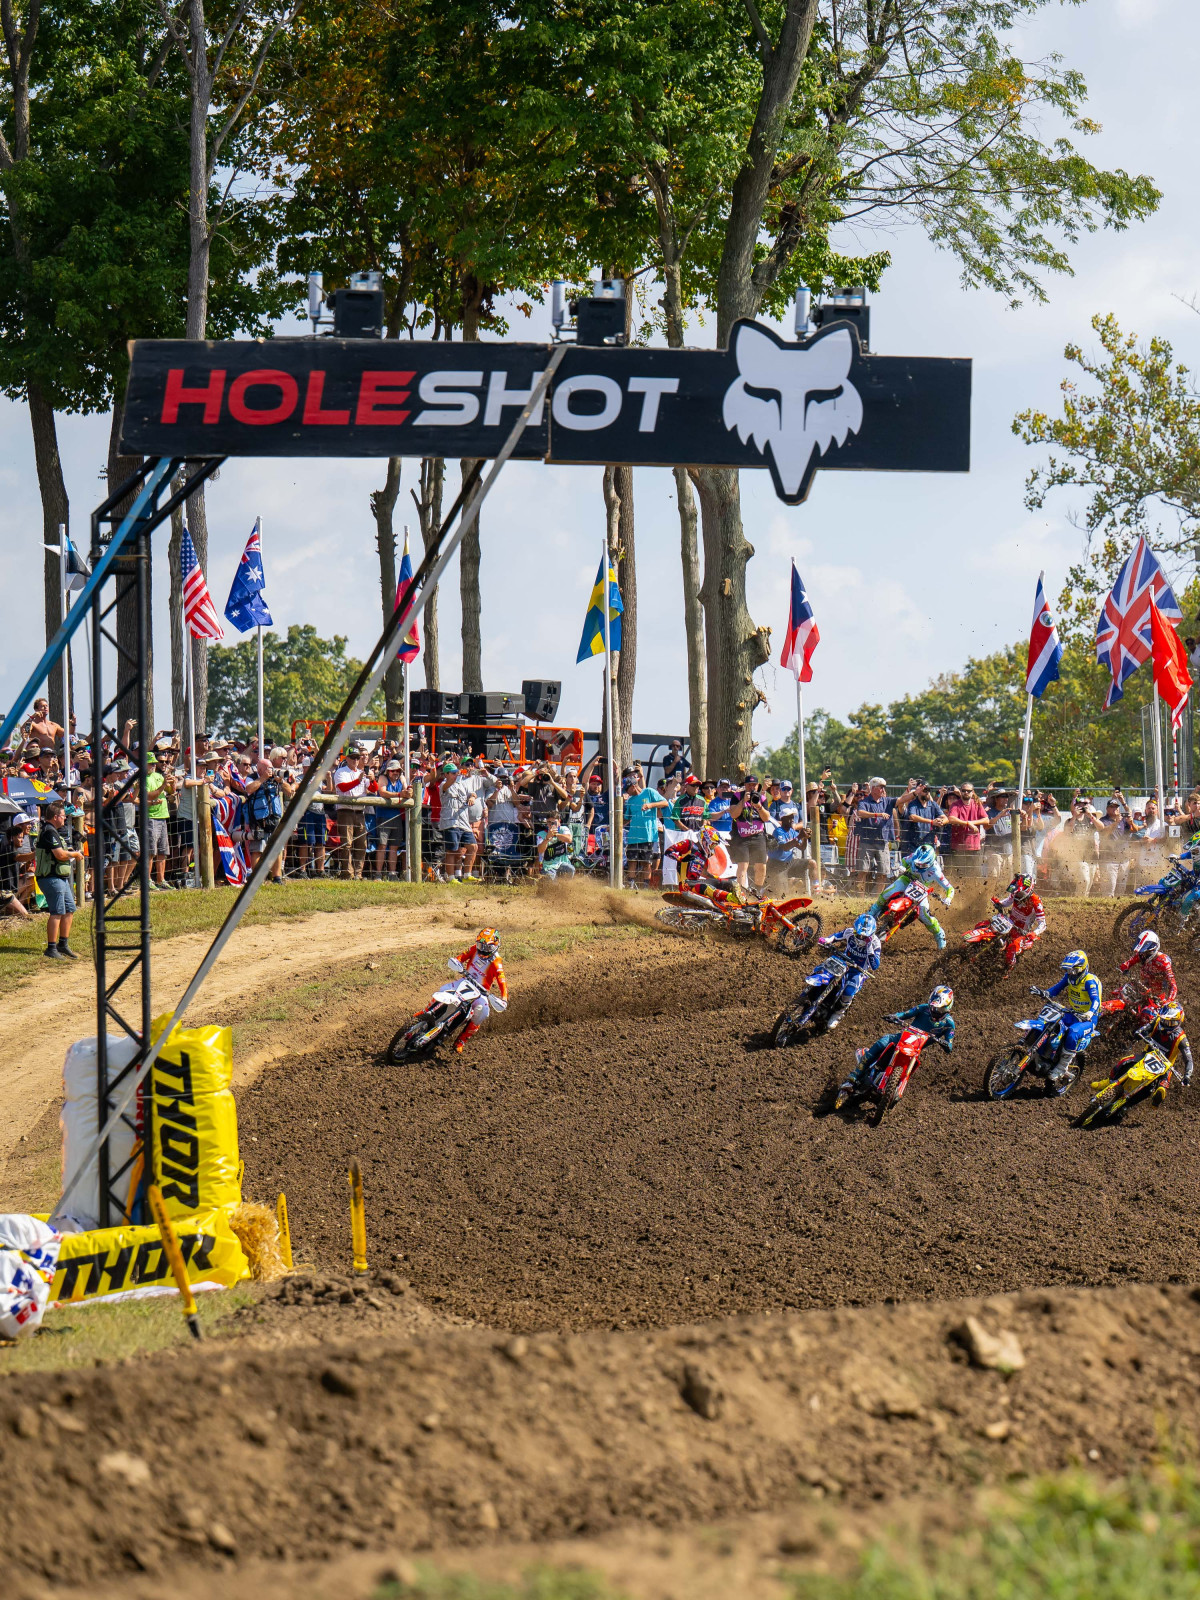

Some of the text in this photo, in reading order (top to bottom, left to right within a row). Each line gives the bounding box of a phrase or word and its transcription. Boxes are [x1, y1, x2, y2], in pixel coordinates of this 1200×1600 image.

[160, 369, 680, 432] HOLESHOT
[905, 886, 924, 898] 19
[460, 984, 475, 995] 7
[904, 1034, 919, 1044] 1
[1145, 1055, 1160, 1072] 16
[154, 1050, 200, 1210] THOR
[56, 1233, 216, 1300] THOR
